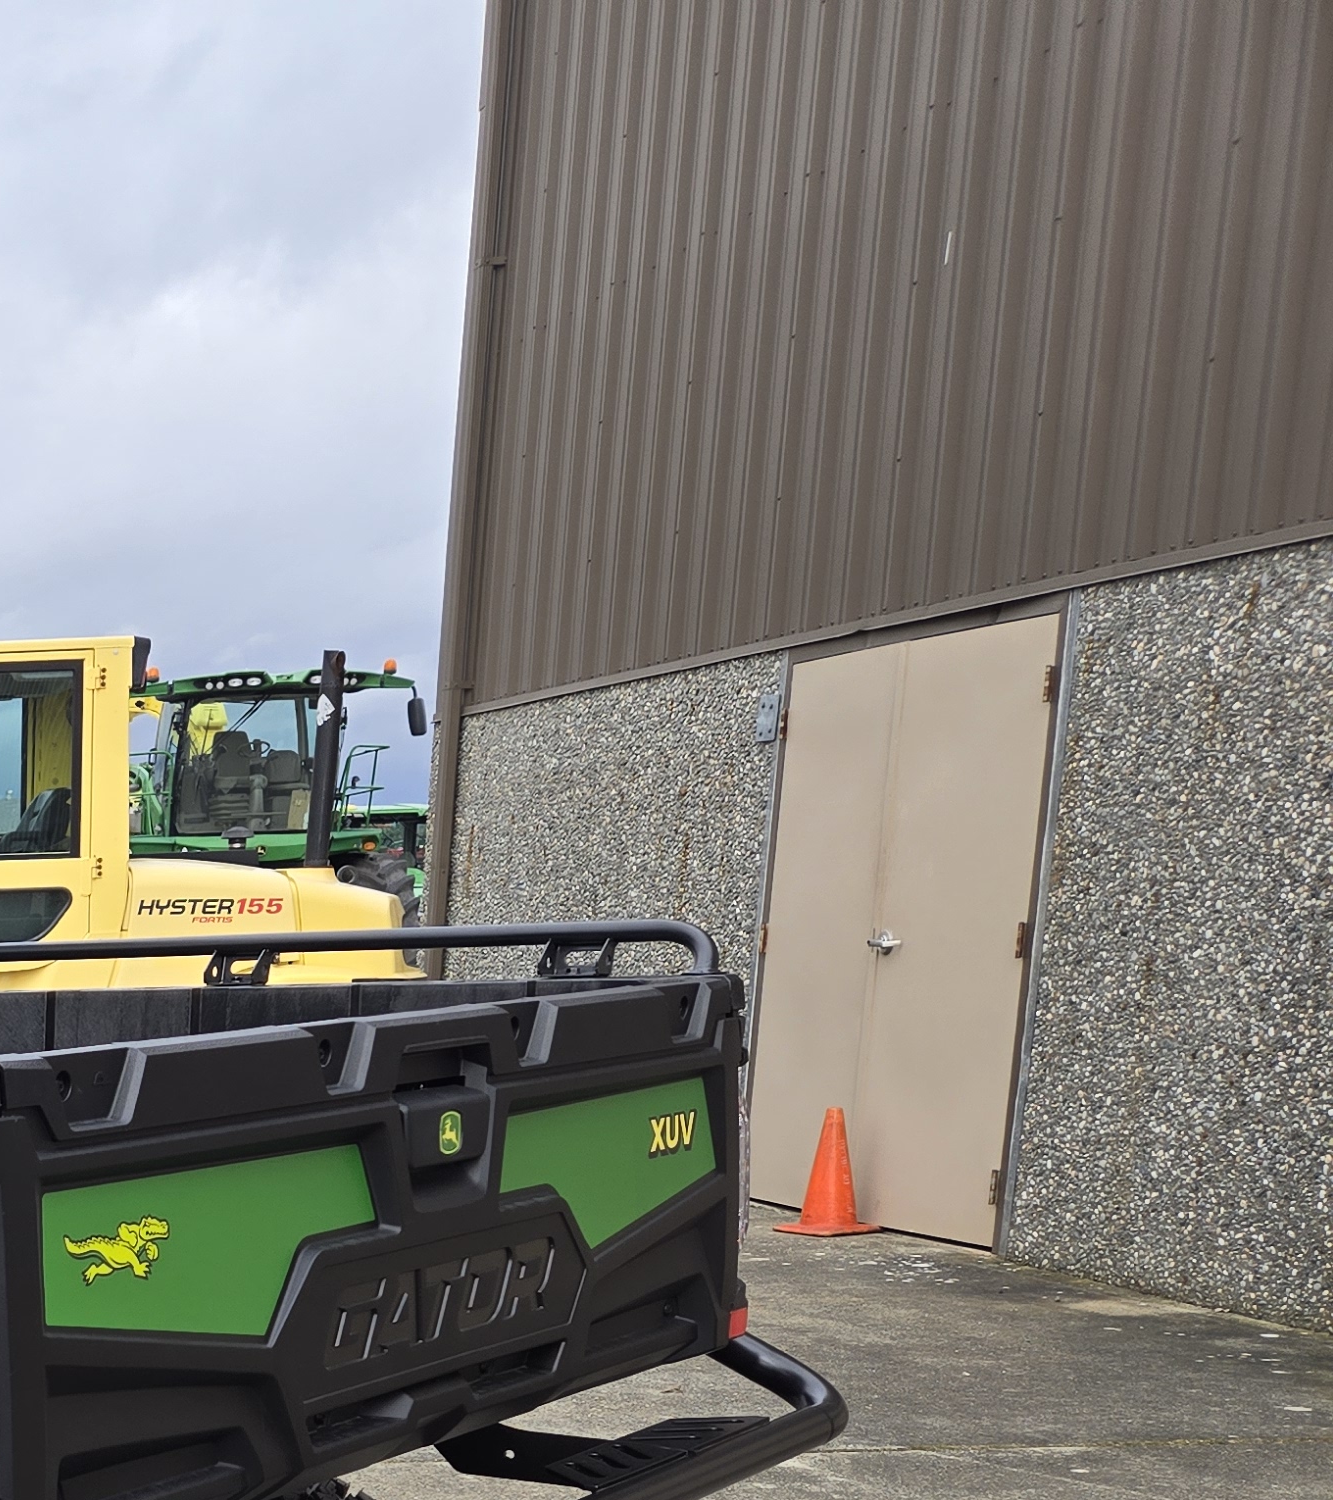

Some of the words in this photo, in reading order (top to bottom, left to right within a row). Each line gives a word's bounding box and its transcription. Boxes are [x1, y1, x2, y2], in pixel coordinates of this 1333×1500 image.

[137, 898, 234, 915] HYSTER
[236, 898, 284, 915] 155
[191, 916, 233, 924] FORTIS
[648, 1109, 697, 1159] XUV
[324, 1236, 556, 1370] GATOR
